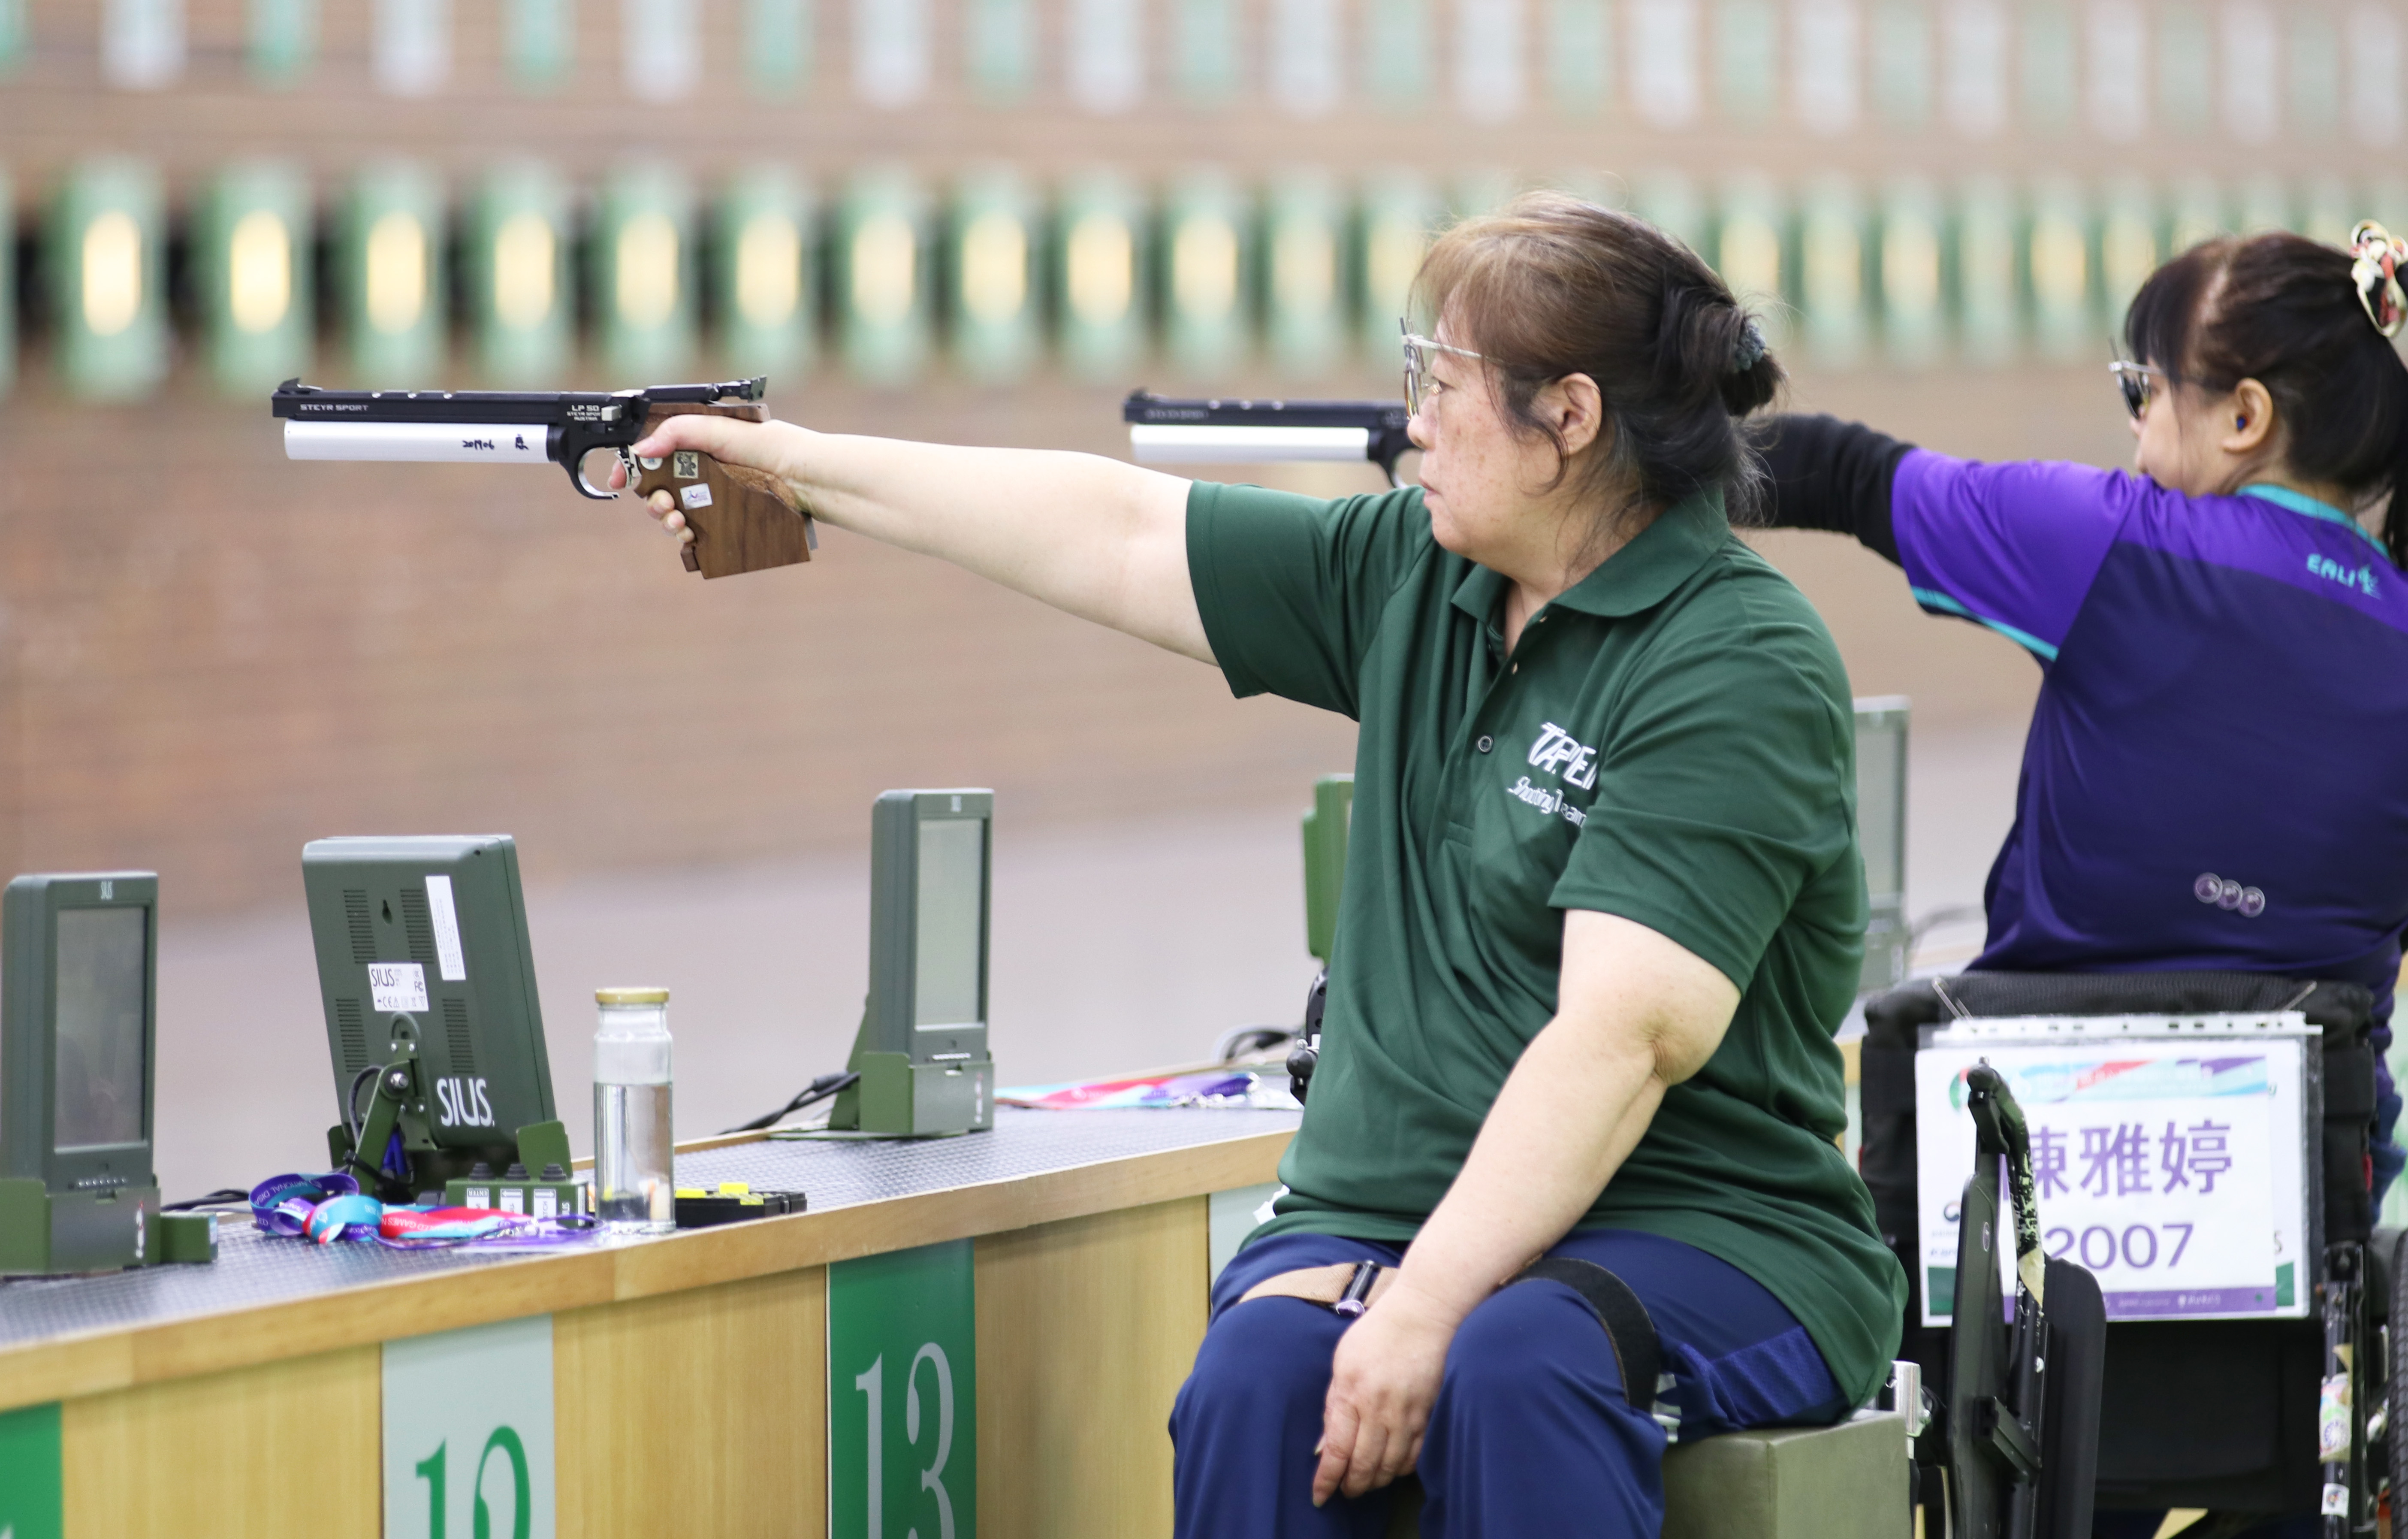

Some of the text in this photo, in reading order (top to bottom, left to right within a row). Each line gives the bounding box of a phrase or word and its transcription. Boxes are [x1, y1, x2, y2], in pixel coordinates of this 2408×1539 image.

[371, 968, 395, 987] SIUS
[437, 1078, 492, 1127] SIUS
[2044, 1224, 2194, 1269] 2007
[856, 1342, 955, 1539] 13
